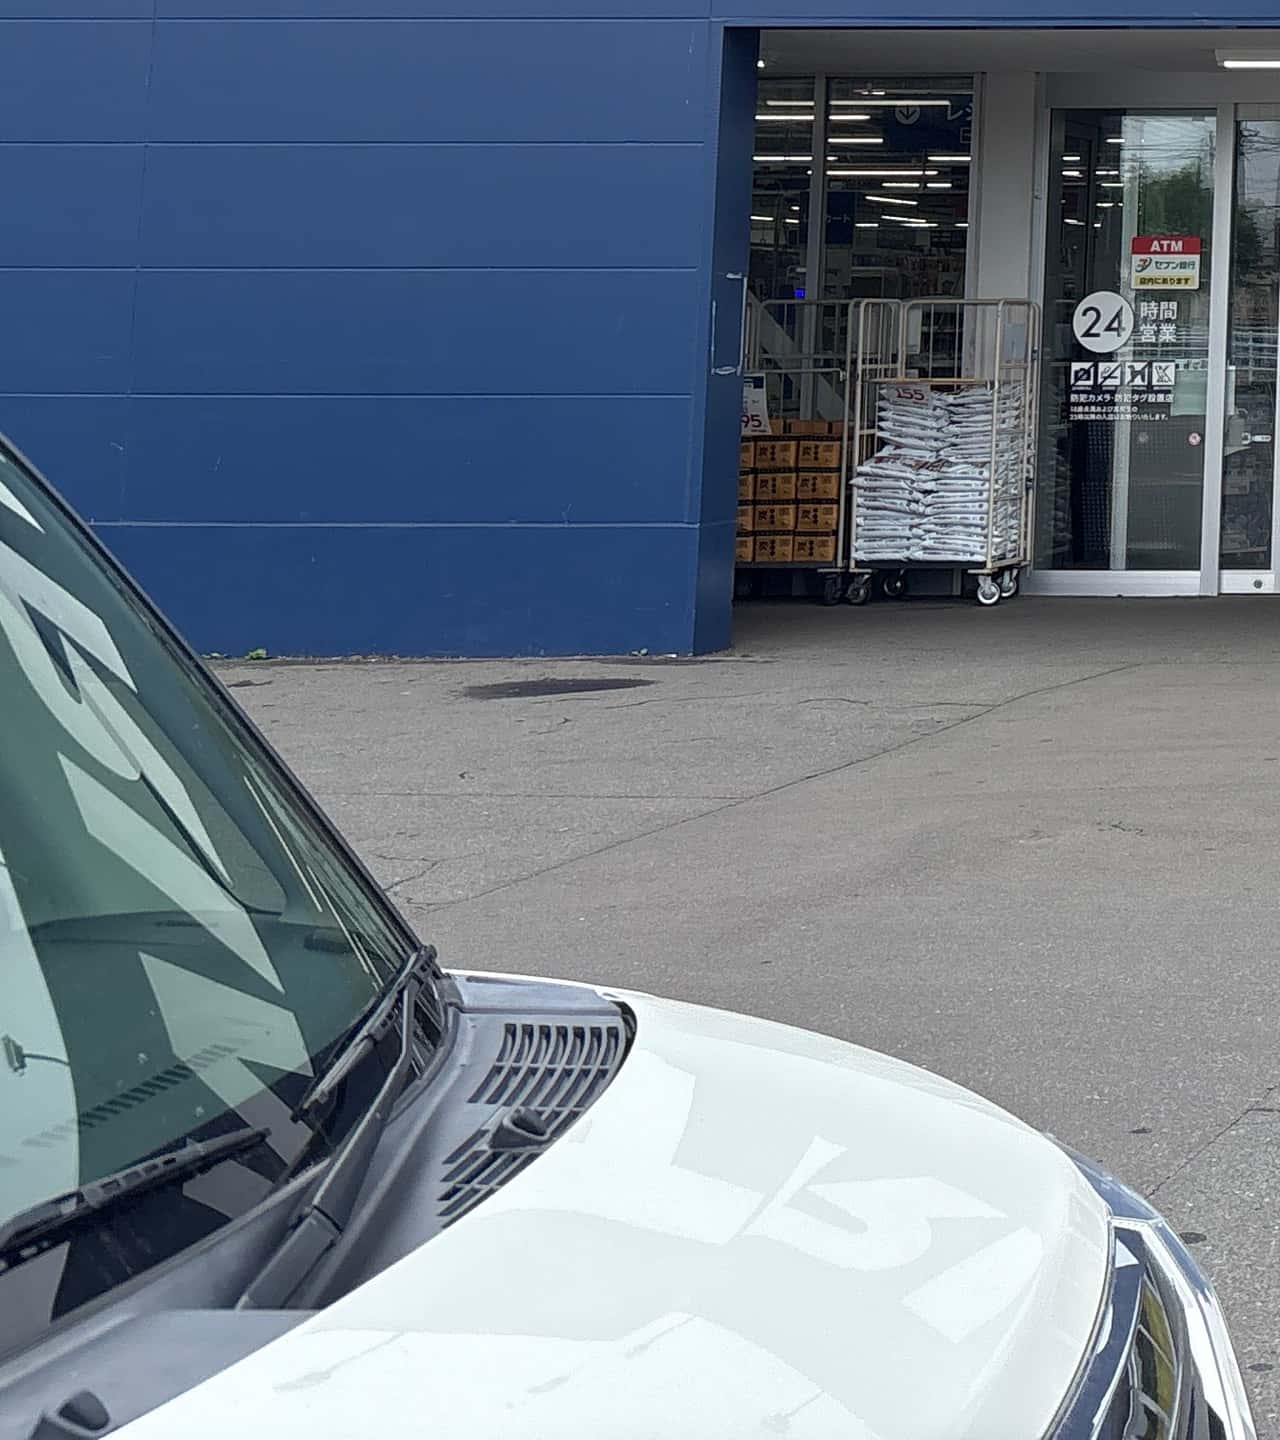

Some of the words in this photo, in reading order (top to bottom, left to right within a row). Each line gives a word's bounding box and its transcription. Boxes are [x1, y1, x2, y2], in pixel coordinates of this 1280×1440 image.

[1150, 240, 1183, 252] ATM
[1154, 260, 1196, 270] セブン銀行
[1139, 277, 1191, 286] 店内にあります
[1140, 301, 1177, 320] 時間
[1080, 305, 1126, 338] 24
[1140, 323, 1177, 342] 営業
